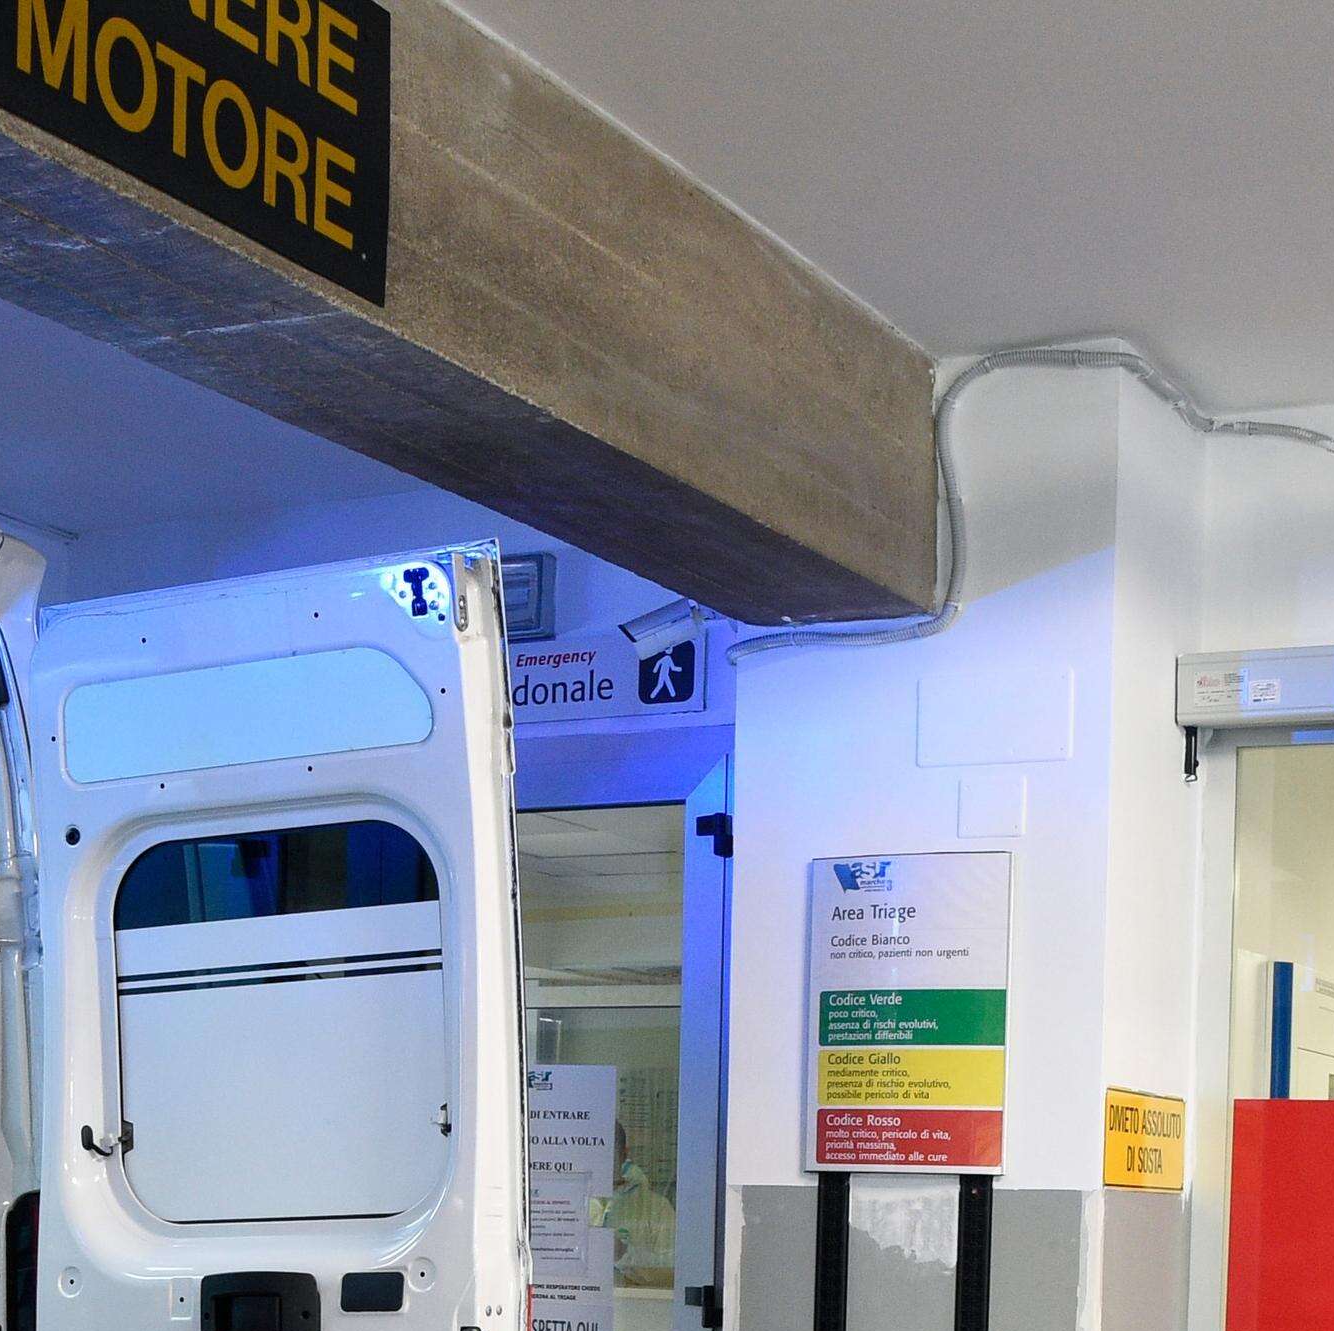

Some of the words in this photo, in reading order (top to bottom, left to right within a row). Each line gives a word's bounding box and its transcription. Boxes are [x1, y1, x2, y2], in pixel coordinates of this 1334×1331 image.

[16, 0, 357, 251] MOTORE
[515, 650, 598, 670] Emergency
[830, 906, 865, 921] Area
[870, 902, 917, 923] Triage
[830, 934, 868, 947] Codice
[871, 932, 911, 946] Bianco
[829, 951, 846, 960] non
[848, 949, 876, 960] critico,
[877, 948, 913, 961] pazienti
[915, 948, 934, 958] non
[936, 946, 970, 960] urgenti
[828, 993, 866, 1006] Codice
[869, 992, 903, 1006] Verde
[828, 1010, 849, 1020] poco
[827, 1021, 860, 1031] assenza
[862, 1020, 871, 1030] di
[873, 1019, 896, 1029] rischi
[898, 1018, 939, 1031] evolutivi,
[827, 1031, 873, 1043] prestazioni
[827, 1053, 865, 1065] Codice
[868, 1051, 902, 1065] Giallo
[827, 1068, 880, 1078] mediamente
[881, 1068, 910, 1079] critico,
[826, 1080, 863, 1091] presenza
[865, 1079, 875, 1089] di
[876, 1078, 905, 1089] rischio
[907, 1078, 952, 1090] evolutivo,
[826, 1089, 863, 1102] possibile
[864, 1090, 900, 1102] pericolo
[902, 1089, 911, 1100] di
[913, 1089, 930, 1100] vita
[542, 1110, 591, 1121] ENTRARE
[825, 1114, 864, 1127] Codice
[866, 1115, 902, 1127] Rosso
[1109, 1104, 1140, 1134] DIVIETO
[1140, 1109, 1182, 1140] ASSOLUTO
[529, 1136, 540, 1146] O
[541, 1136, 569, 1146] ALLA
[570, 1136, 606, 1147] VOLTA
[825, 1130, 850, 1139] molto
[881, 1130, 918, 1141] pericolo
[919, 1129, 930, 1140] di
[931, 1130, 952, 1141] vita,
[856, 1140, 897, 1152] massima,
[824, 1152, 857, 1161] accesso
[858, 1151, 906, 1162] immediato
[908, 1152, 925, 1162] alle
[926, 1154, 949, 1163] cure
[1126, 1145, 1136, 1172] DI
[1137, 1146, 1163, 1174] SOSTA
[554, 1162, 574, 1173] QUI
